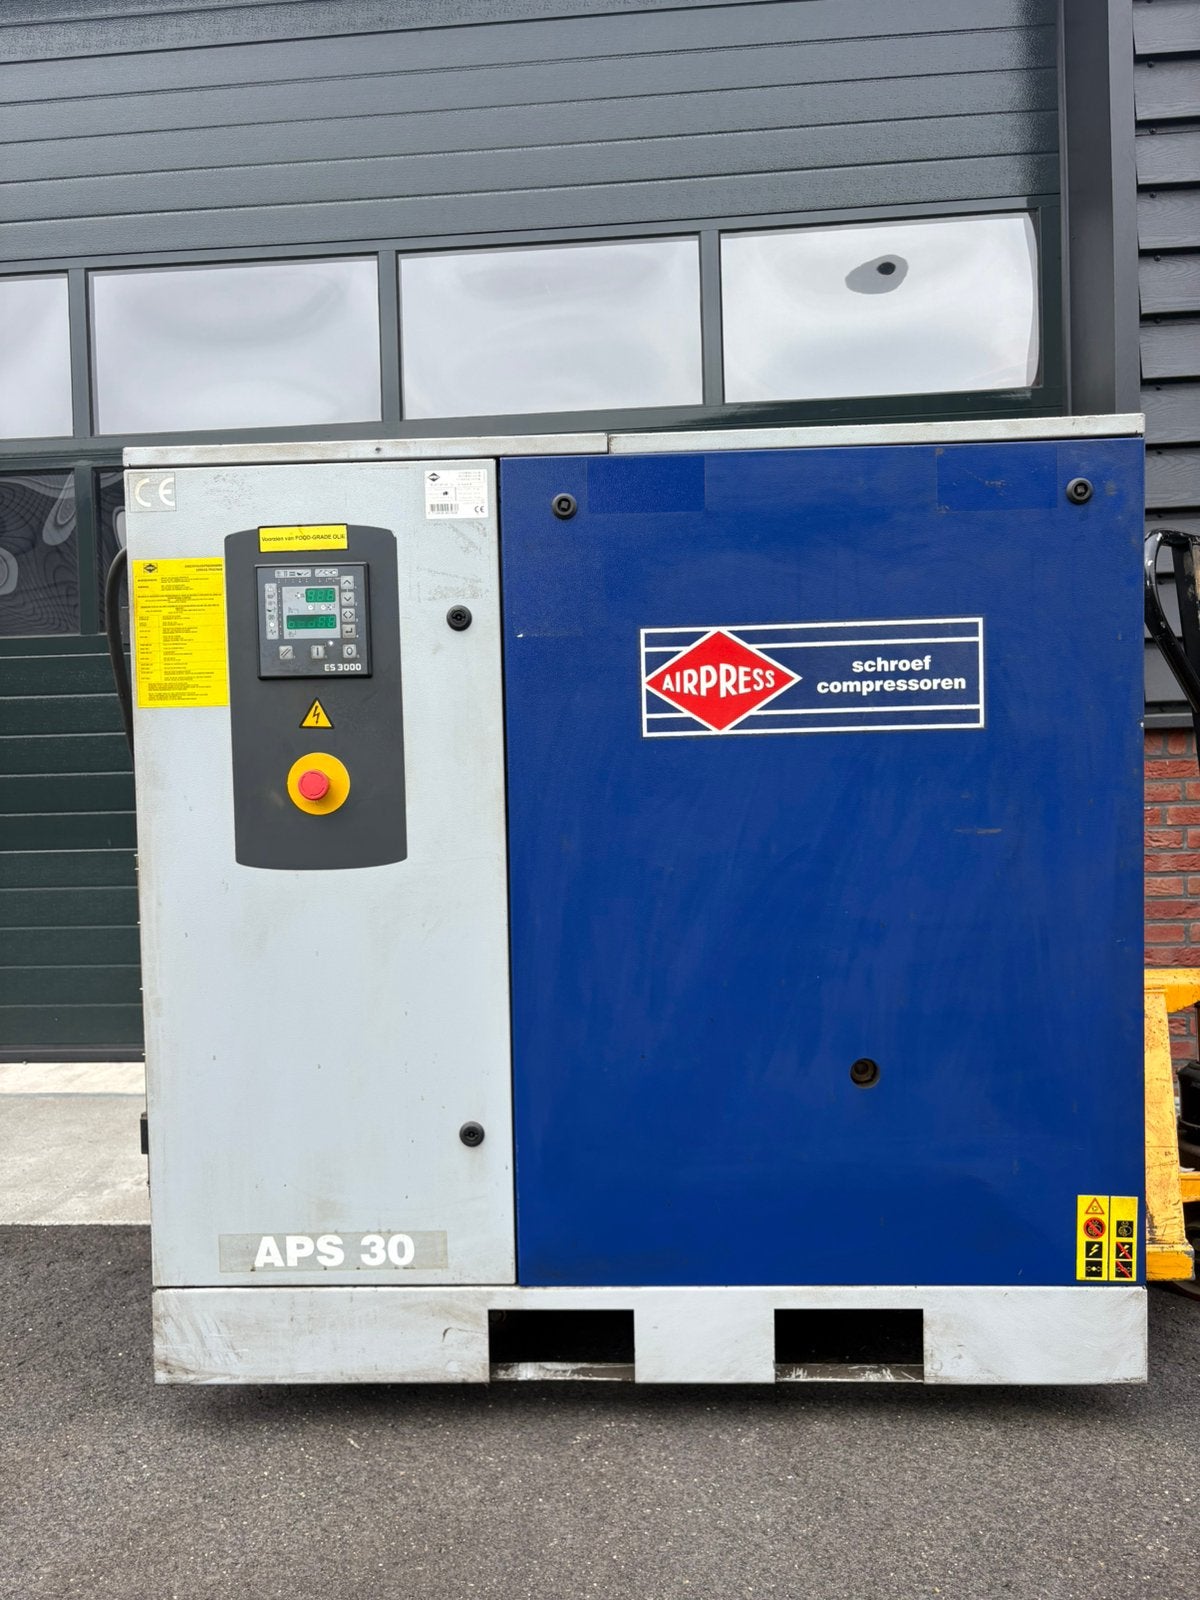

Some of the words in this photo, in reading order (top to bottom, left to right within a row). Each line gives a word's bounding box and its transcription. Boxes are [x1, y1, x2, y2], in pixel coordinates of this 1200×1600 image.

[134, 477, 175, 507] CE
[324, 663, 336, 672] ES
[337, 663, 362, 671] 3000
[852, 655, 932, 673] schroef
[662, 663, 775, 698] AIRPRESS
[816, 676, 966, 696] compressoren
[254, 1234, 345, 1267] APS
[360, 1234, 415, 1266] 30
